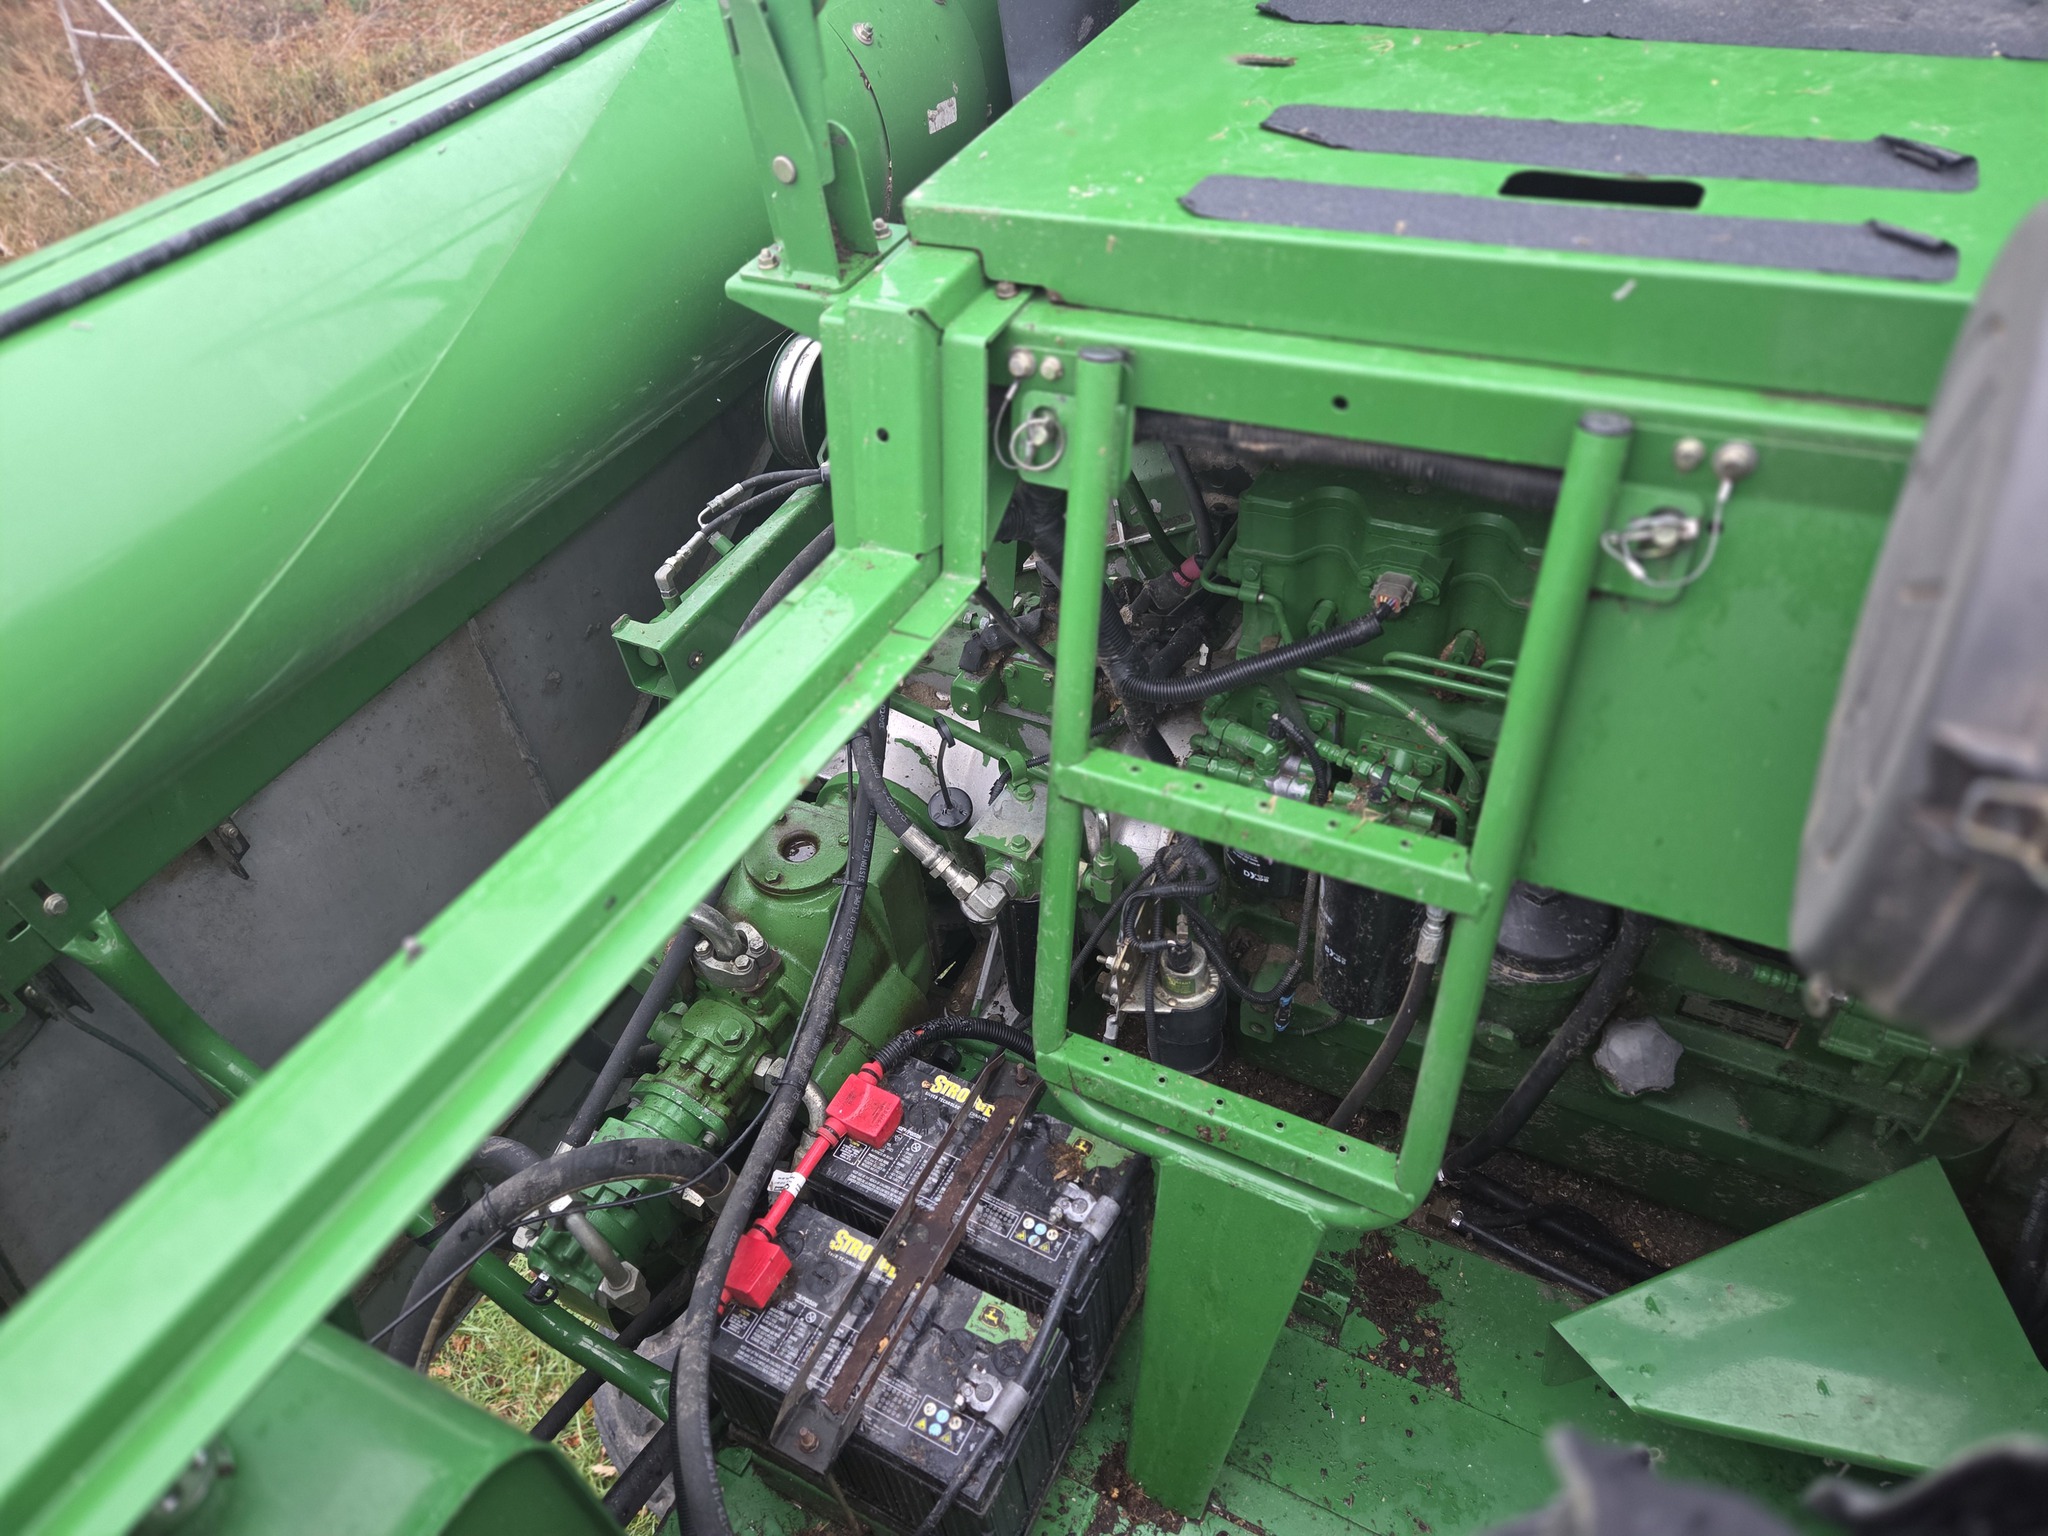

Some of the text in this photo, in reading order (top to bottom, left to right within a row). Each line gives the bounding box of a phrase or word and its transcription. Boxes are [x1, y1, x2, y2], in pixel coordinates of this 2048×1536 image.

[877, 704, 887, 728] DAYCO
[855, 854, 870, 890] RSISTANT
[852, 893, 862, 913] FLAME
[793, 1072, 808, 1101] EXCEDS
